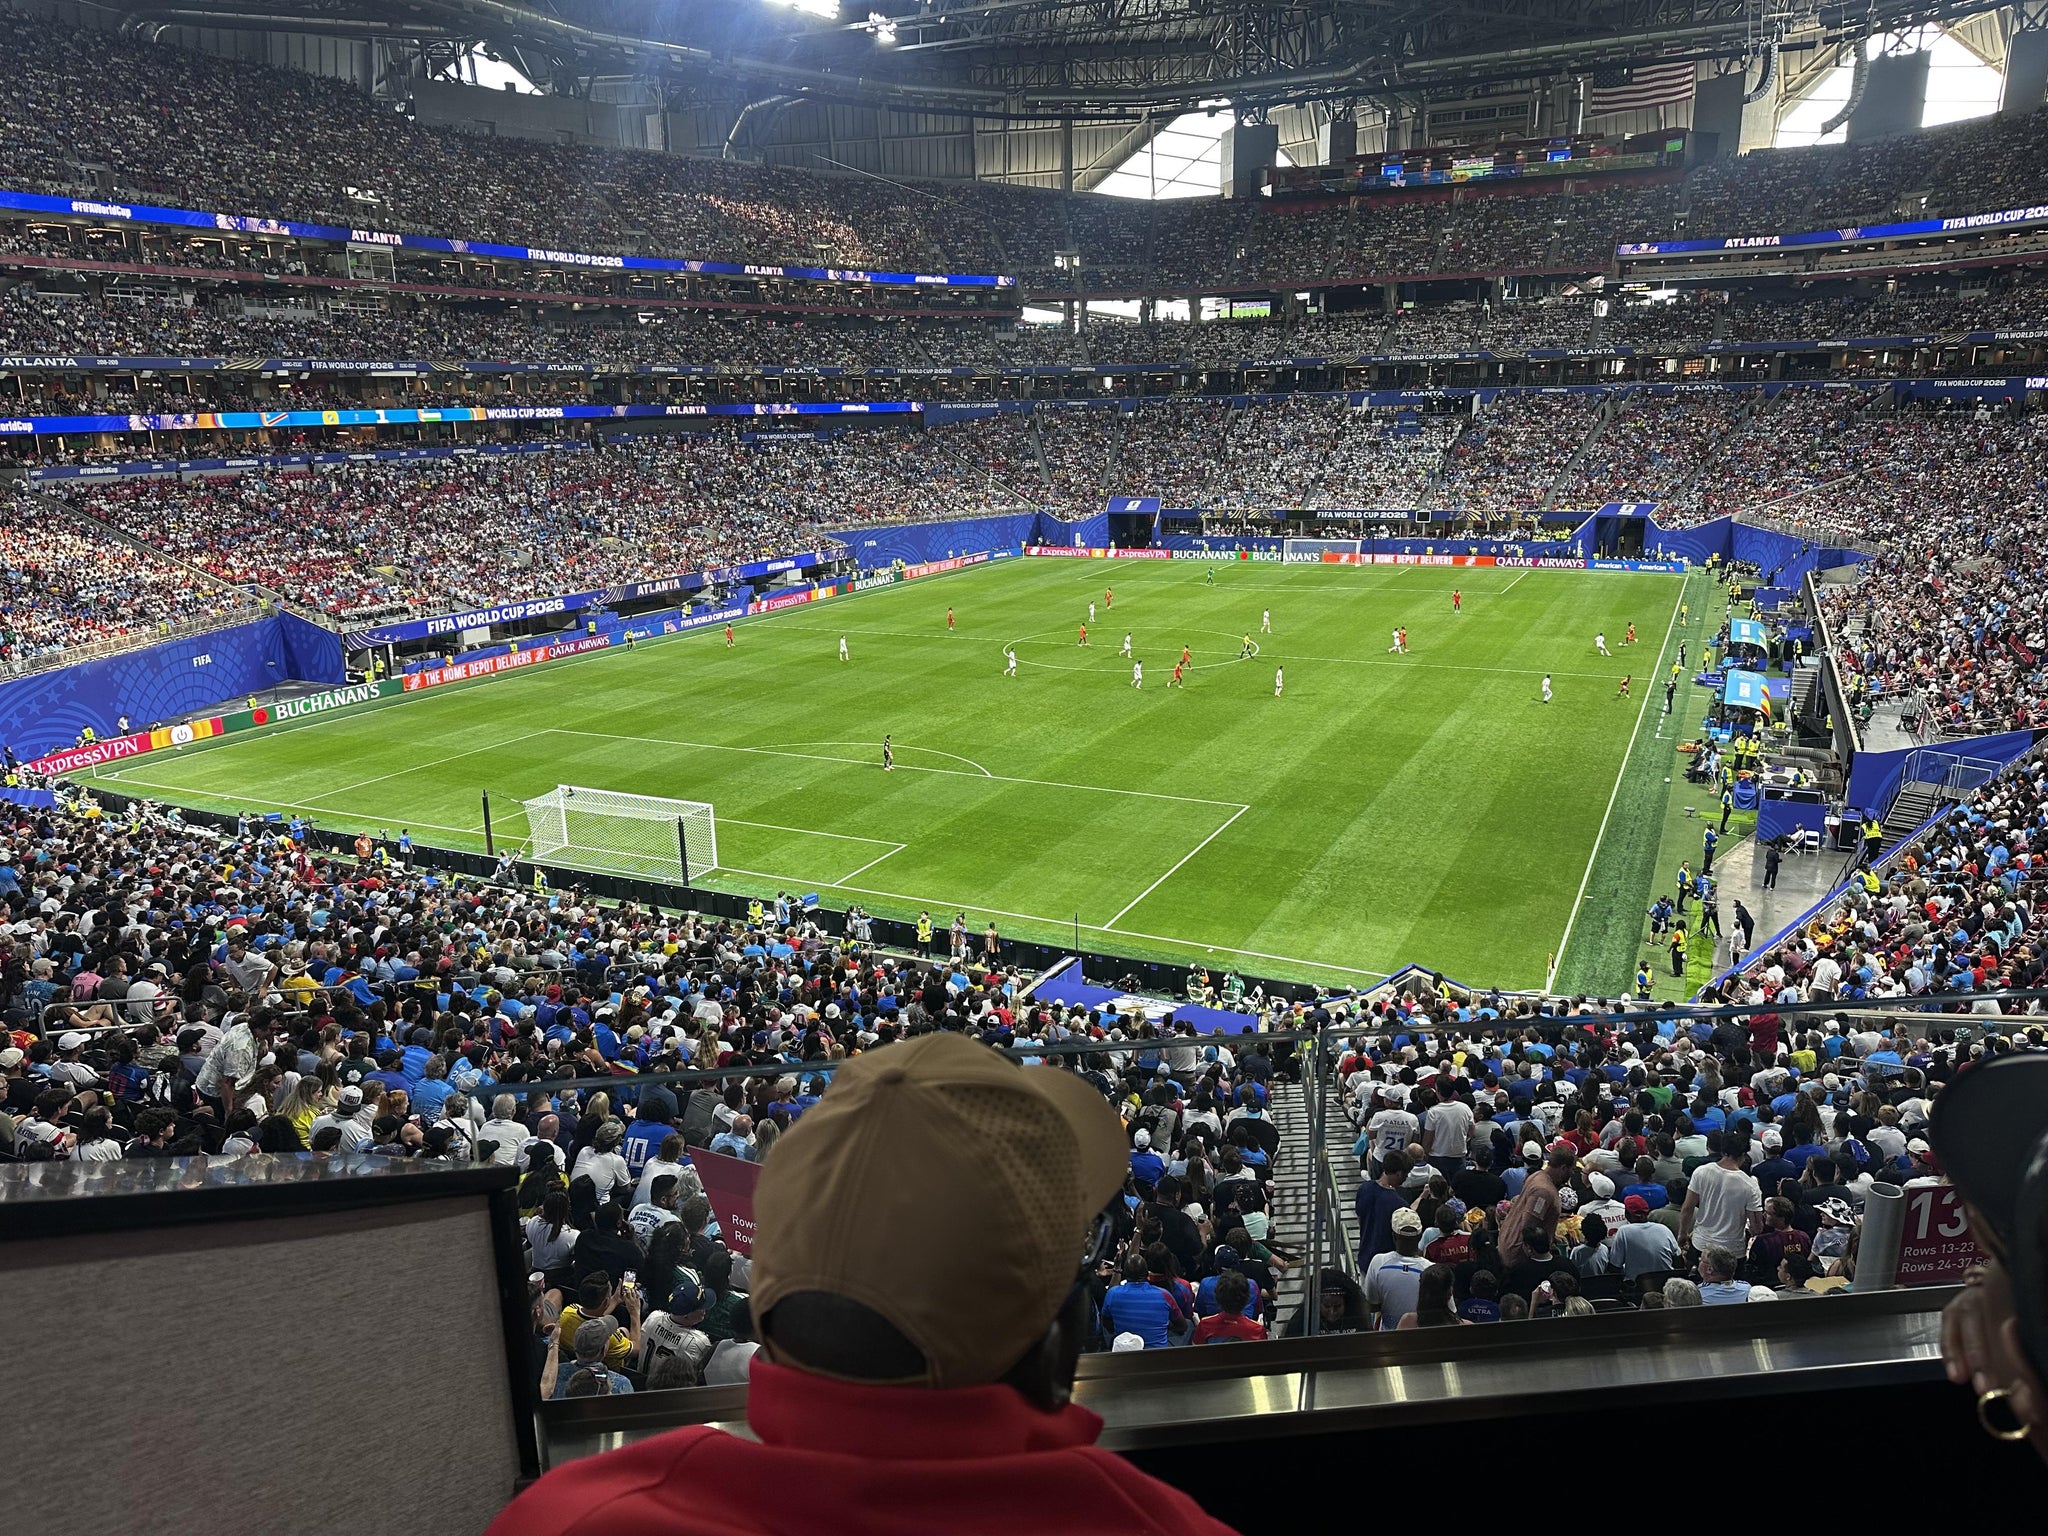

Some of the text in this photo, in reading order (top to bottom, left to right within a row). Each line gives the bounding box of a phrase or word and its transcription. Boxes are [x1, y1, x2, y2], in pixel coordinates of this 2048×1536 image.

[71, 201, 132, 219] #FIFAWorldCup
[1942, 205, 2048, 230] FIFA WORLD CUP 202
[351, 230, 403, 246] ATLANTA
[1724, 235, 1780, 248] ATLANTA
[527, 249, 624, 267] FIFA WORLD CUP 2026
[744, 264, 784, 276] ATLANTA
[1995, 332, 2010, 340] FIFA
[1, 357, 78, 367] ATLANTA
[311, 362, 329, 370] FIFA
[329, 362, 354, 370] WORLD
[355, 362, 369, 370] CUP
[370, 362, 394, 370] 2026
[2032, 377, 2045, 388] CUP
[375, 410, 389, 424] 1
[487, 407, 563, 419] WORLD CUP 2026
[665, 406, 707, 415] ATLANTA
[0, 420, 33, 433] orldCup
[1041, 548, 1089, 557] ExpressVPN
[1119, 548, 1167, 558] ExpressVPN
[1172, 550, 1236, 561] BUCHANAN'S
[1375, 554, 1395, 564] HOME
[1396, 555, 1417, 564] DEPOT
[1418, 555, 1453, 565] DELIVERS
[1496, 557, 1585, 568] QATAR AIRWAYS
[1594, 561, 1622, 569] American
[1638, 563, 1666, 571] American
[637, 578, 680, 596] ATLANTA
[855, 573, 895, 591] BUCHANAN'S
[769, 593, 807, 609] ExpressVPN
[427, 599, 565, 634] FIFA WORLD CUP 2026
[680, 618, 693, 627] FIFA
[693, 615, 712, 625] WORLD
[713, 612, 724, 621] CUP
[549, 636, 610, 658] QATAR AIRWAYS
[193, 653, 212, 667] FIFA
[424, 653, 532, 686] THE HOME DEPOT DELIVERS
[274, 684, 381, 721] BUCHANAN'S
[38, 739, 139, 774] ExpressVPN
[1384, 1137, 1405, 1151] 21
[626, 1136, 649, 1168] 10
[732, 1214, 759, 1231] Rows
[1903, 1241, 1975, 1257] Rows 13-23
[1901, 1262, 1934, 1273] Rows
[1937, 1257, 1972, 1271] 24-37
[1467, 1307, 1492, 1315] ULTRA
[655, 1324, 682, 1346] TANAKA
